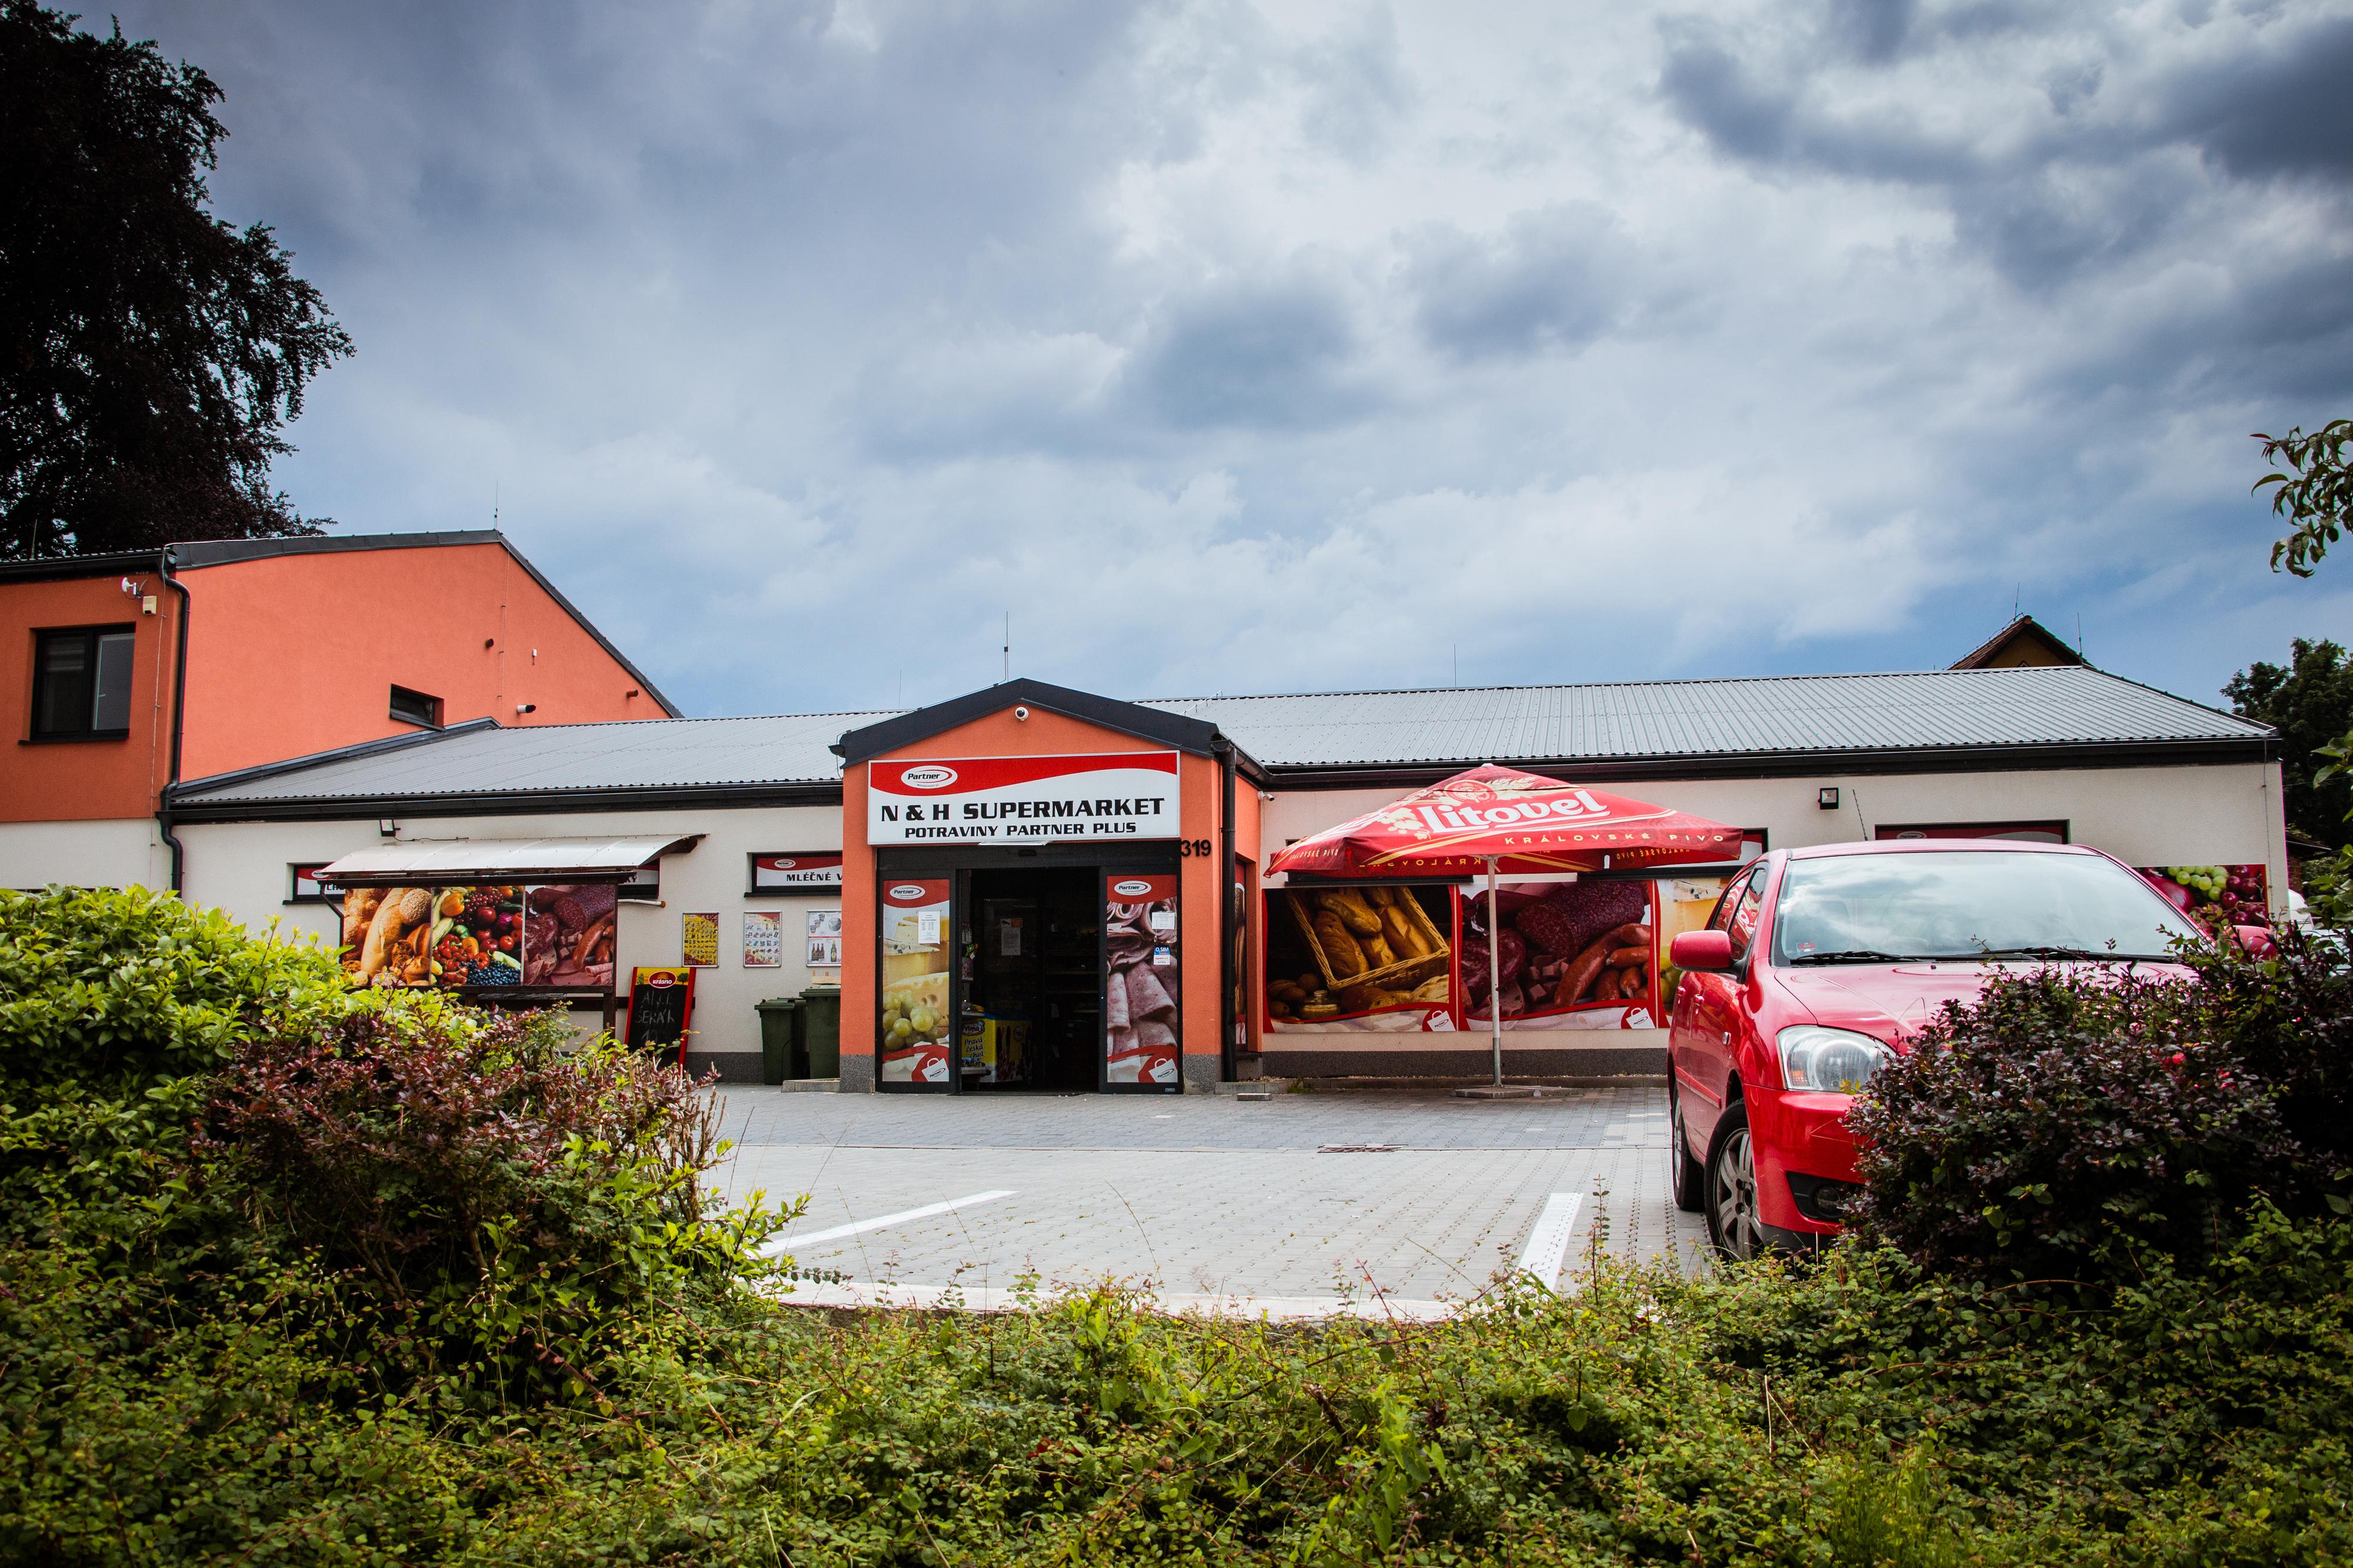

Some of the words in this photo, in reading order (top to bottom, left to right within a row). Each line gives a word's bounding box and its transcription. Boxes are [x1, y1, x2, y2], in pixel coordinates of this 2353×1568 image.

[881, 805, 899, 822] N
[906, 805, 925, 821] &
[932, 803, 950, 820] H
[963, 798, 1165, 819] SUPERMARKET
[1417, 790, 1608, 833] Litovel
[905, 825, 999, 838] POTRAVINY
[1006, 823, 1085, 836] PARTNER
[1093, 822, 1136, 833] PLUS
[1505, 832, 1651, 845] KRÁLOVSKÉ
[1669, 834, 1724, 842] PIVO
[1181, 839, 1211, 857] 319
[1324, 848, 1339, 857] PIVO
[786, 872, 831, 881] MLÉČNÉ
[965, 1036, 983, 1046] Pravá
